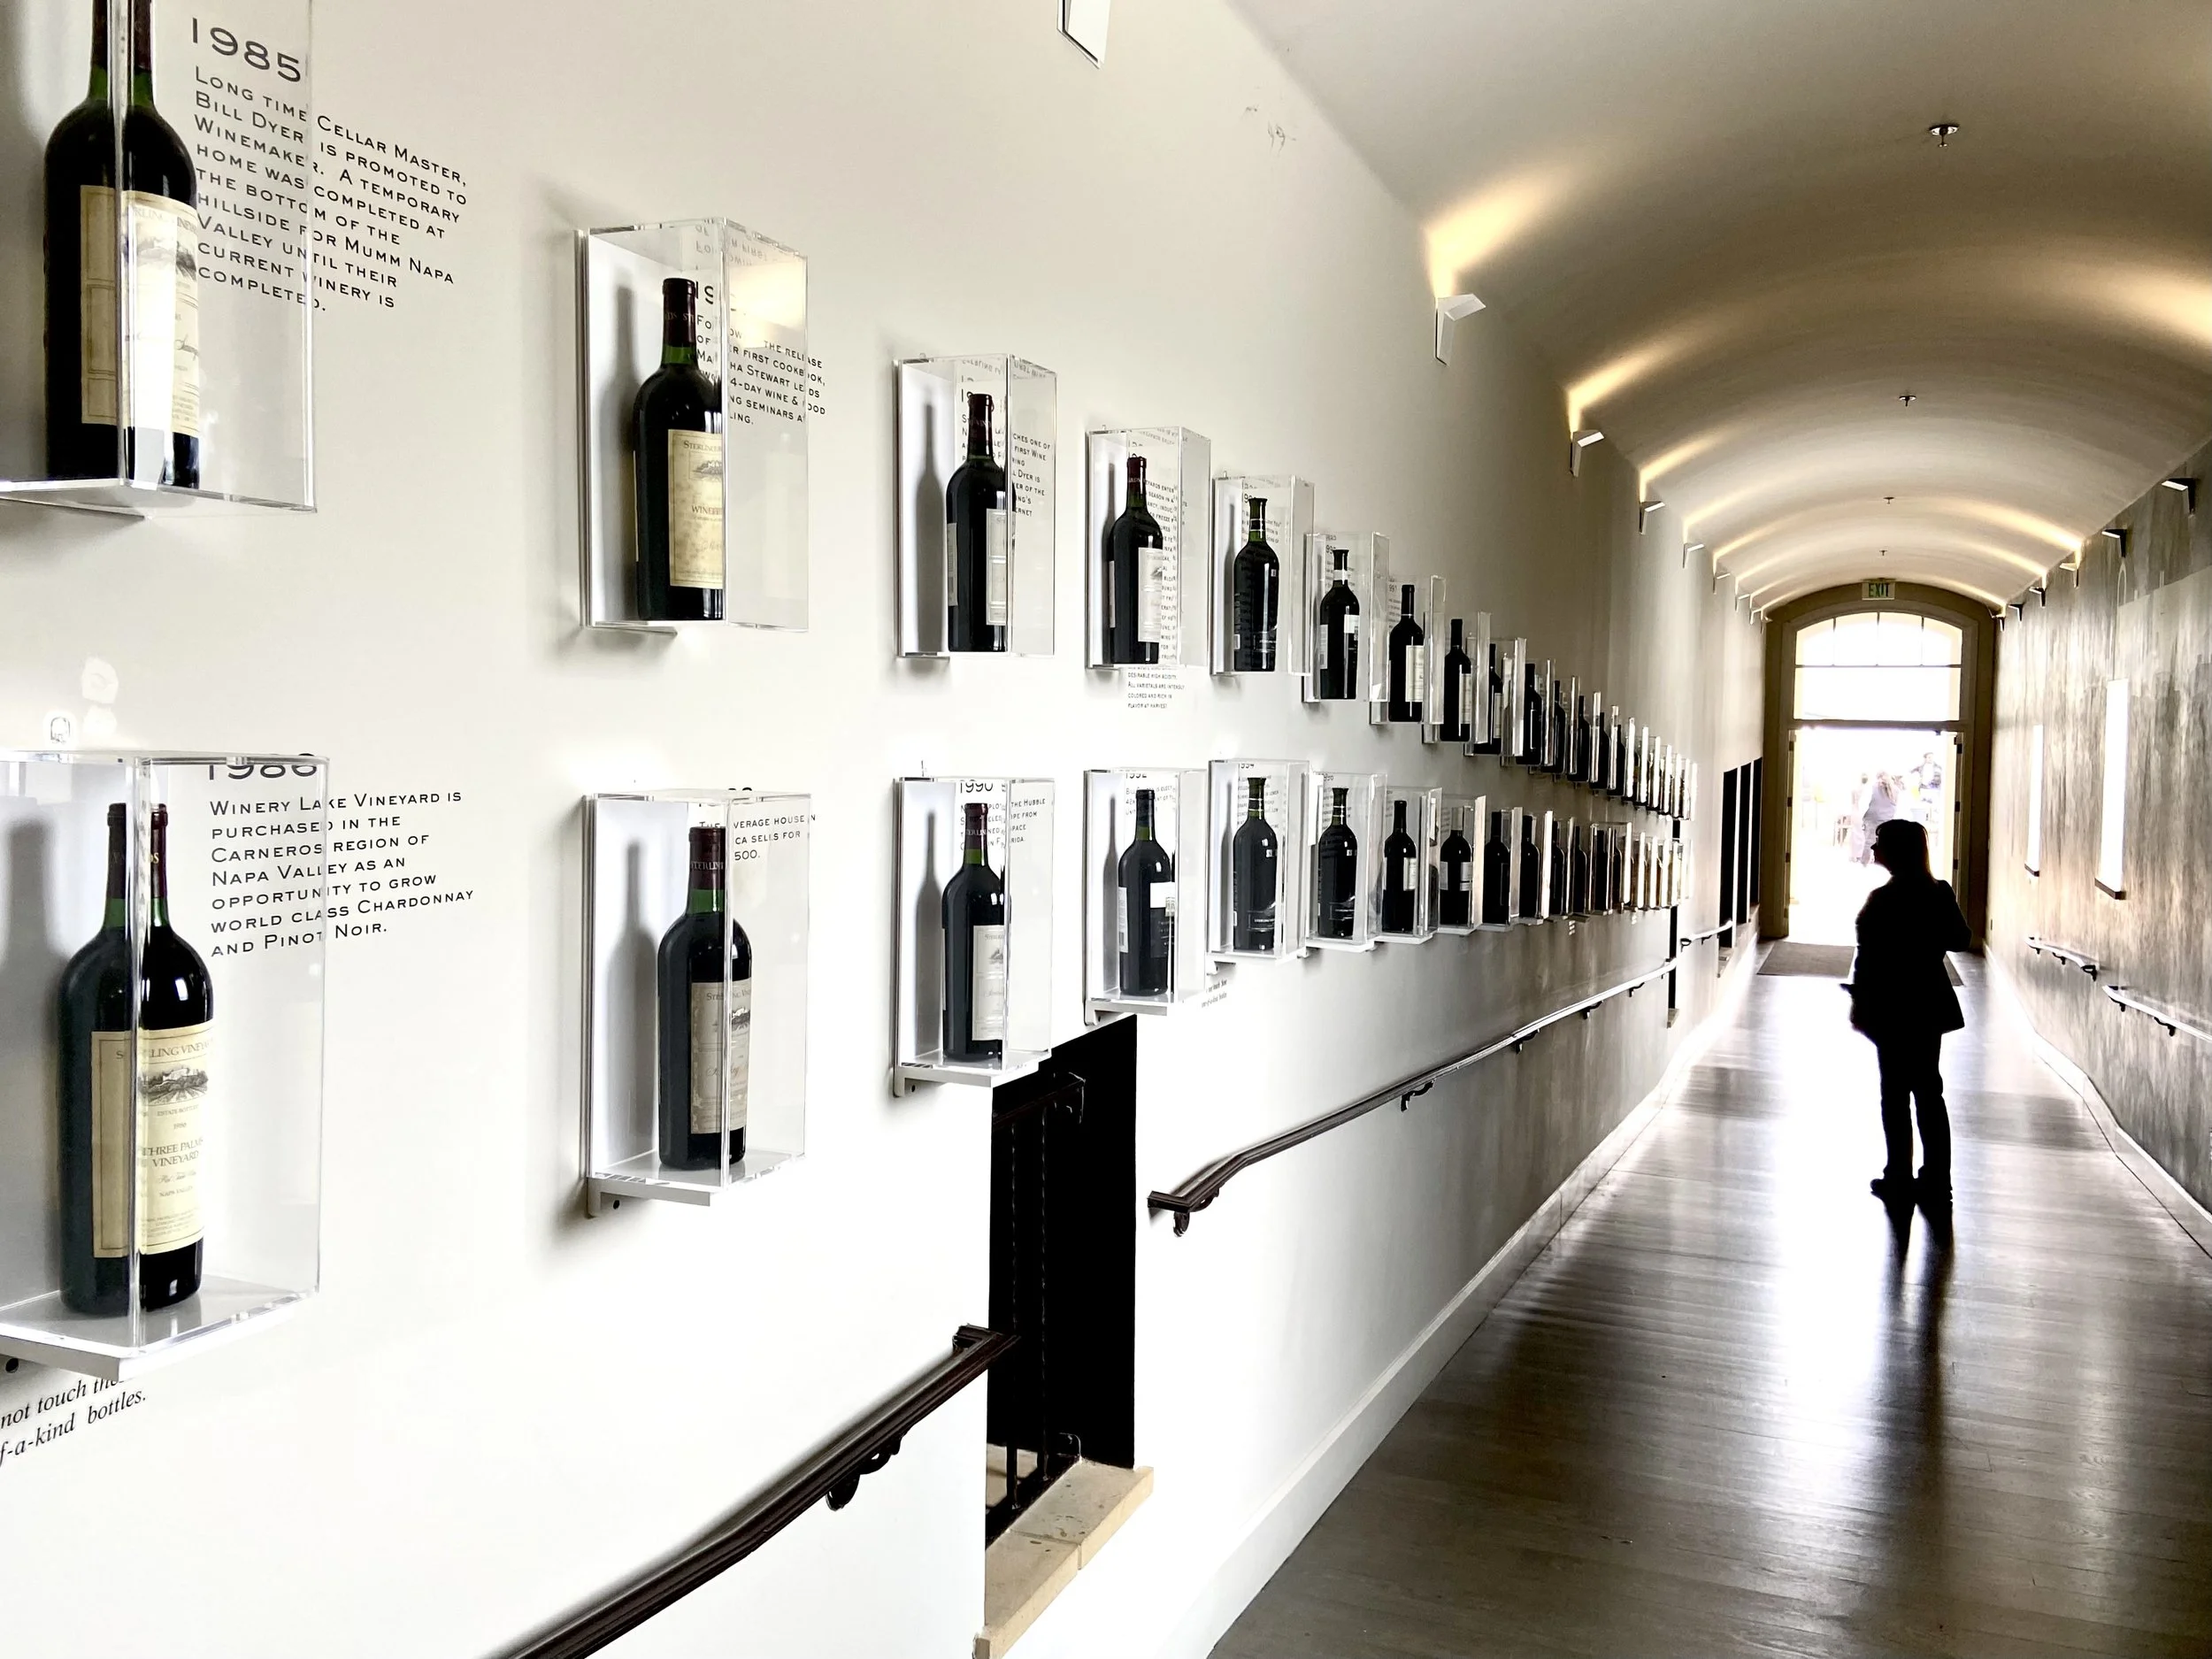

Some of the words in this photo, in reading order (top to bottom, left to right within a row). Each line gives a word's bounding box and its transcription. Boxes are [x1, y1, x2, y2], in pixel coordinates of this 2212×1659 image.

[192, 18, 301, 82] 1985
[263, 96, 306, 122] TIME
[320, 142, 336, 157] IS
[346, 151, 441, 195] PROMOTED
[447, 190, 466, 205] TO
[196, 144, 257, 173] HOME
[265, 167, 304, 189] WAS
[314, 186, 419, 229] COMPLETED
[426, 226, 445, 239] AT
[340, 169, 352, 185] A
[360, 178, 460, 223] TEMPORARY
[196, 168, 236, 190] THE
[335, 215, 359, 230] OF
[367, 225, 400, 245] THE
[197, 193, 289, 231] HILLSIDE
[197, 242, 295, 278] CURRENT
[379, 295, 394, 308] IS
[345, 264, 397, 288] THEIR
[743, 349, 769, 365] FIRST
[764, 389, 788, 404] WINE
[791, 396, 798, 405] &
[794, 382, 820, 398] LEDS
[746, 400, 795, 421] SEMINARS
[1869, 582, 1890, 597] EXIT
[210, 800, 291, 816] WINERY
[447, 792, 462, 802] IS
[342, 819, 359, 829] IN
[367, 816, 401, 828] THE
[774, 815, 804, 825] HOUSE
[334, 836, 399, 853] REGION
[407, 834, 430, 846] OF
[783, 831, 801, 840] FOR
[355, 859, 377, 872] AS
[383, 857, 405, 869] AN
[359, 880, 380, 892] TO
[388, 874, 437, 889] GROW
[211, 915, 282, 934] WORLD
[211, 941, 254, 957] AND
[37, 1377, 86, 1414] touch
[88, 1391, 146, 1424] bottles.
